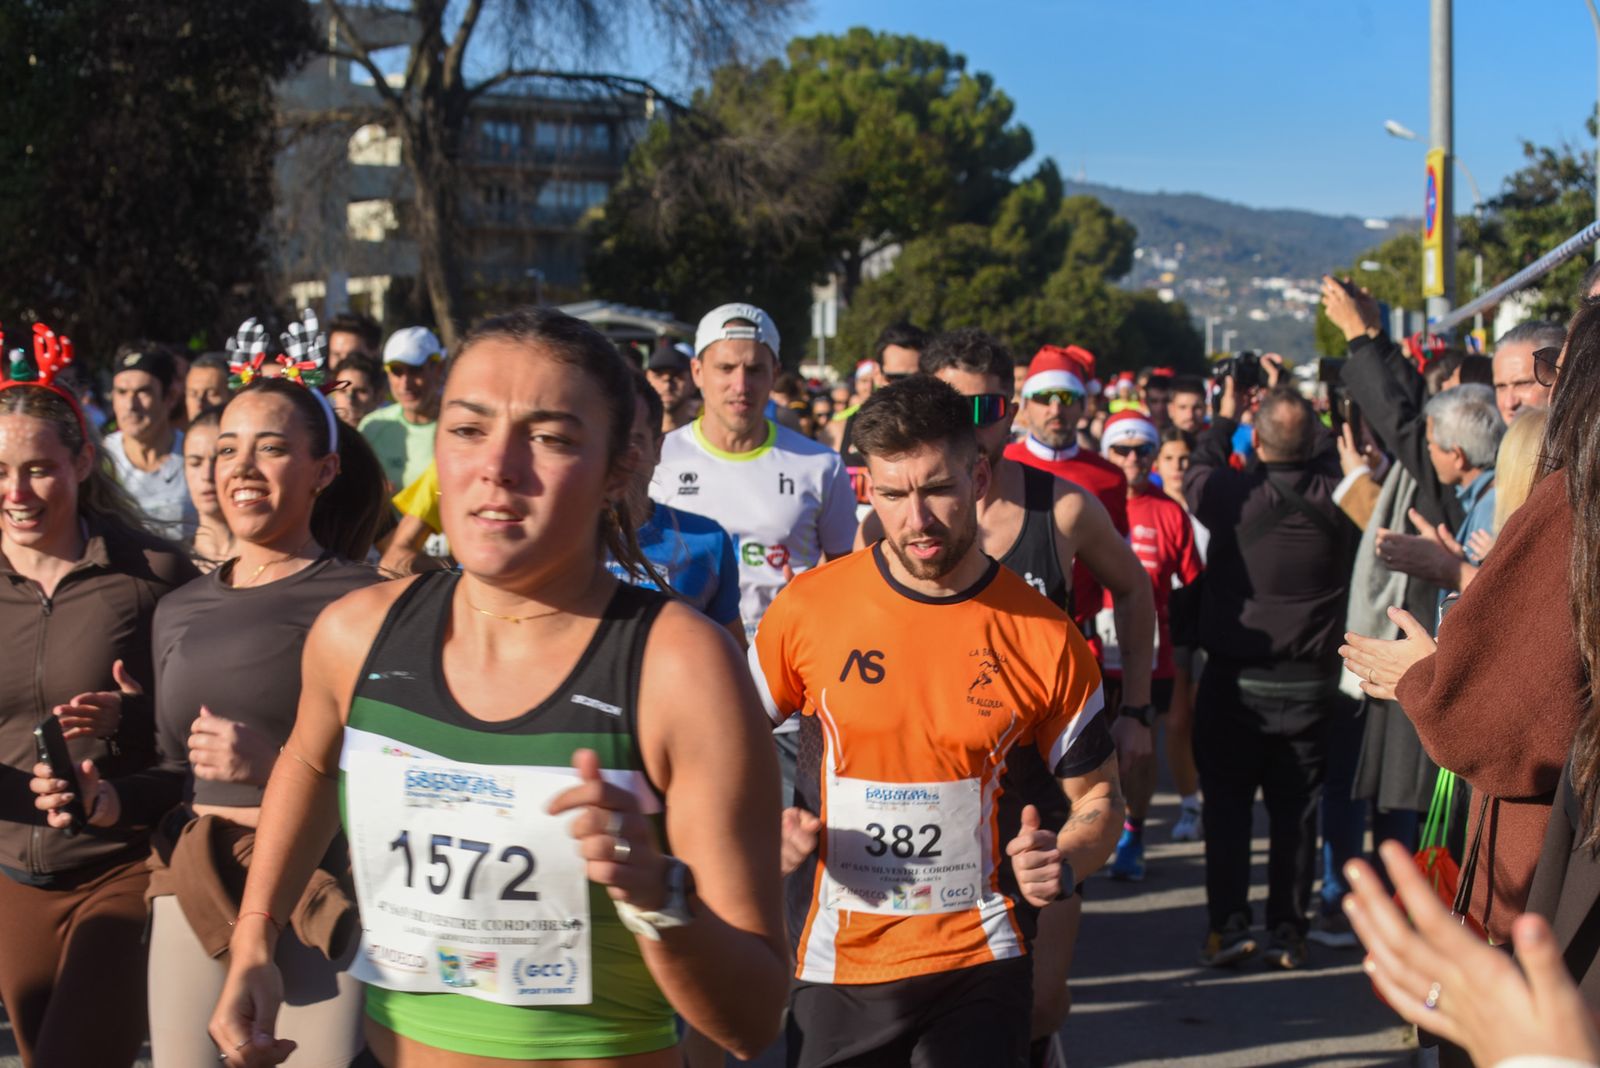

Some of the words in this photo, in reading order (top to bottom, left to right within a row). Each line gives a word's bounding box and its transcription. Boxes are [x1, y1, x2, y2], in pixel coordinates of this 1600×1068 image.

[864, 822, 942, 859] 382
[390, 829, 540, 901] 1572
[923, 862, 977, 875] CORDOBESA
[946, 887, 969, 898] GCC
[525, 963, 565, 978] GCC
